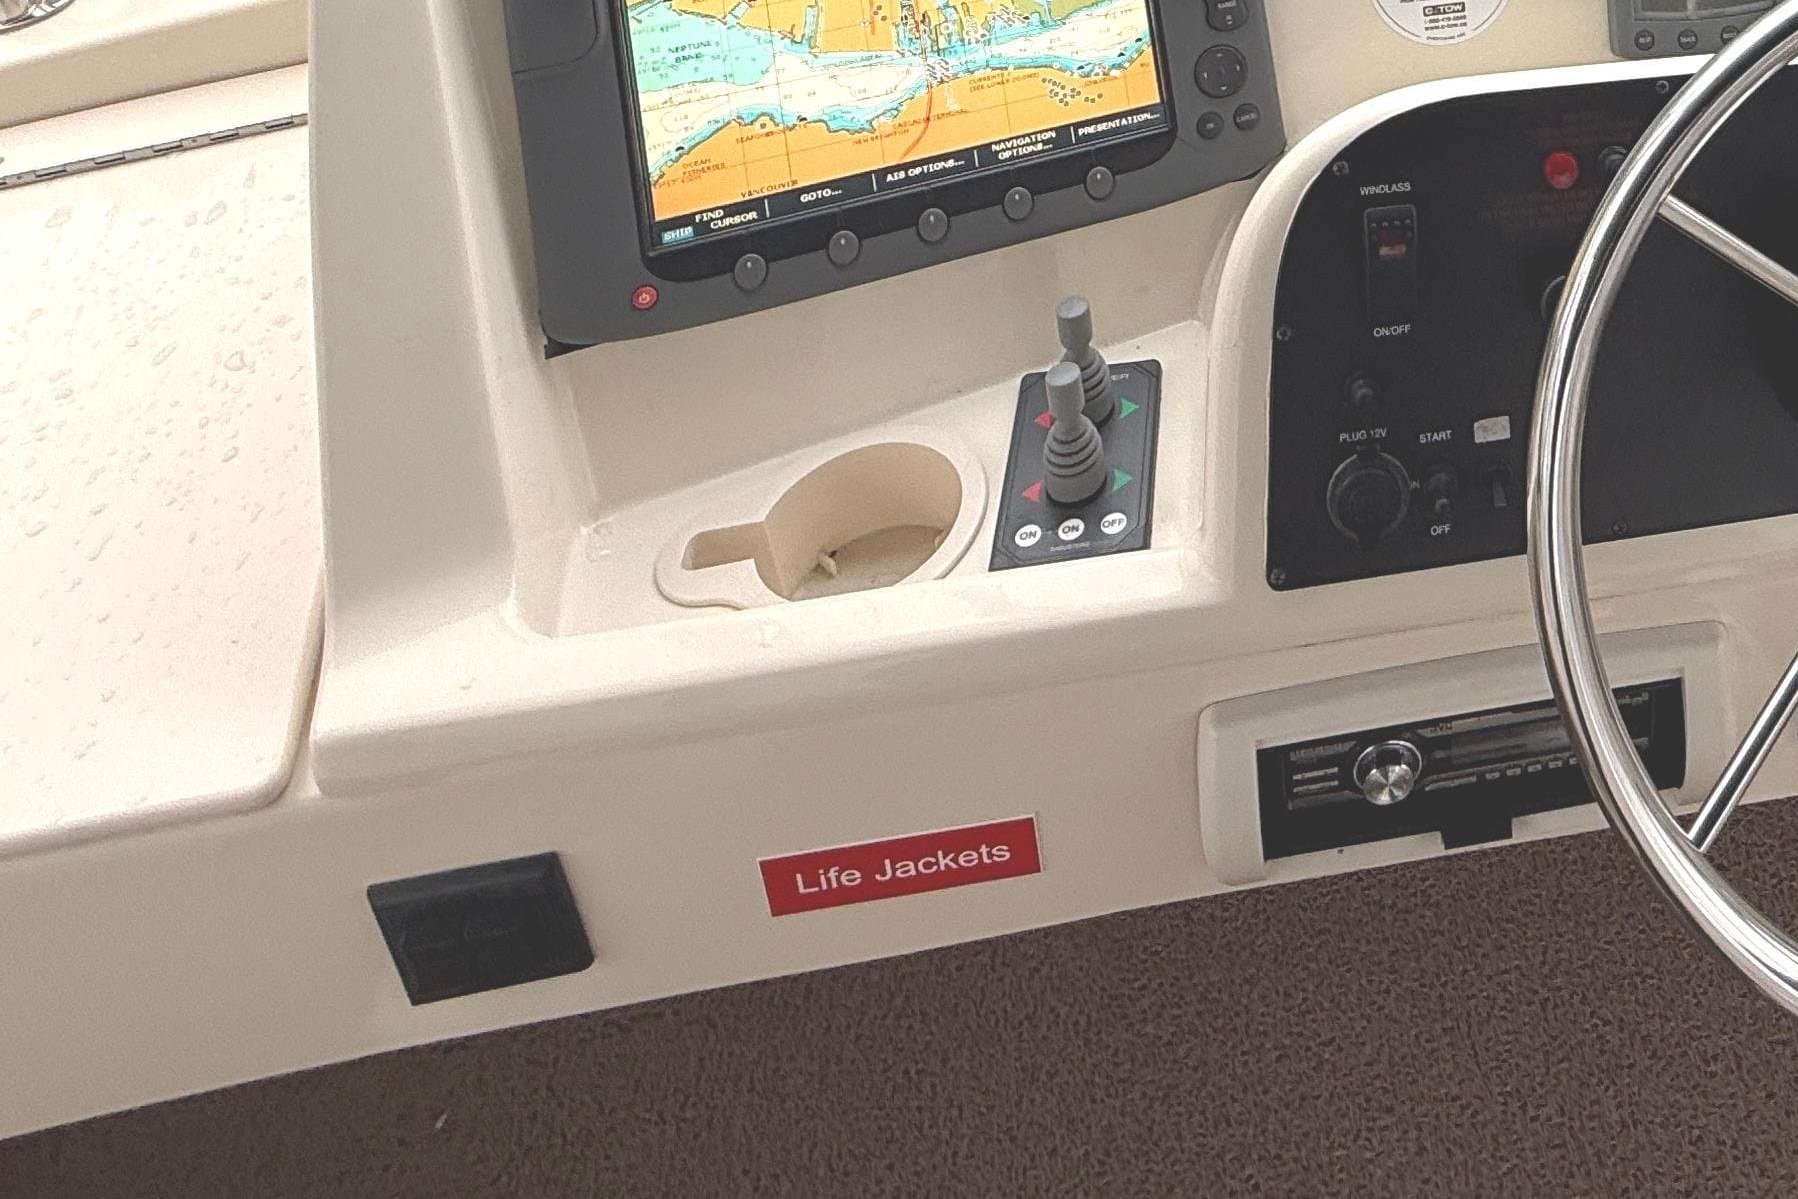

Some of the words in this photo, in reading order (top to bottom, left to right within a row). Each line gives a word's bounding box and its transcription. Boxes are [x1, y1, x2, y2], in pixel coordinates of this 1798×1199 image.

[991, 131, 1056, 151] NAVIGATION
[886, 171, 905, 183] AIS
[1360, 182, 1411, 196] WINDLASS
[695, 209, 724, 222] FIND
[710, 212, 758, 229] CURSOR
[663, 228, 693, 241] SHIP
[1373, 323, 1411, 337] ON/OFF
[1340, 431, 1367, 442] PLUG
[1370, 428, 1388, 439] 12V
[1419, 430, 1453, 443] START
[1061, 524, 1080, 534] ON
[1102, 518, 1125, 529] OFF
[1430, 524, 1450, 536] OFF
[1019, 530, 1037, 541] ON
[795, 867, 863, 895] Life
[875, 843, 1011, 882] Jackets
